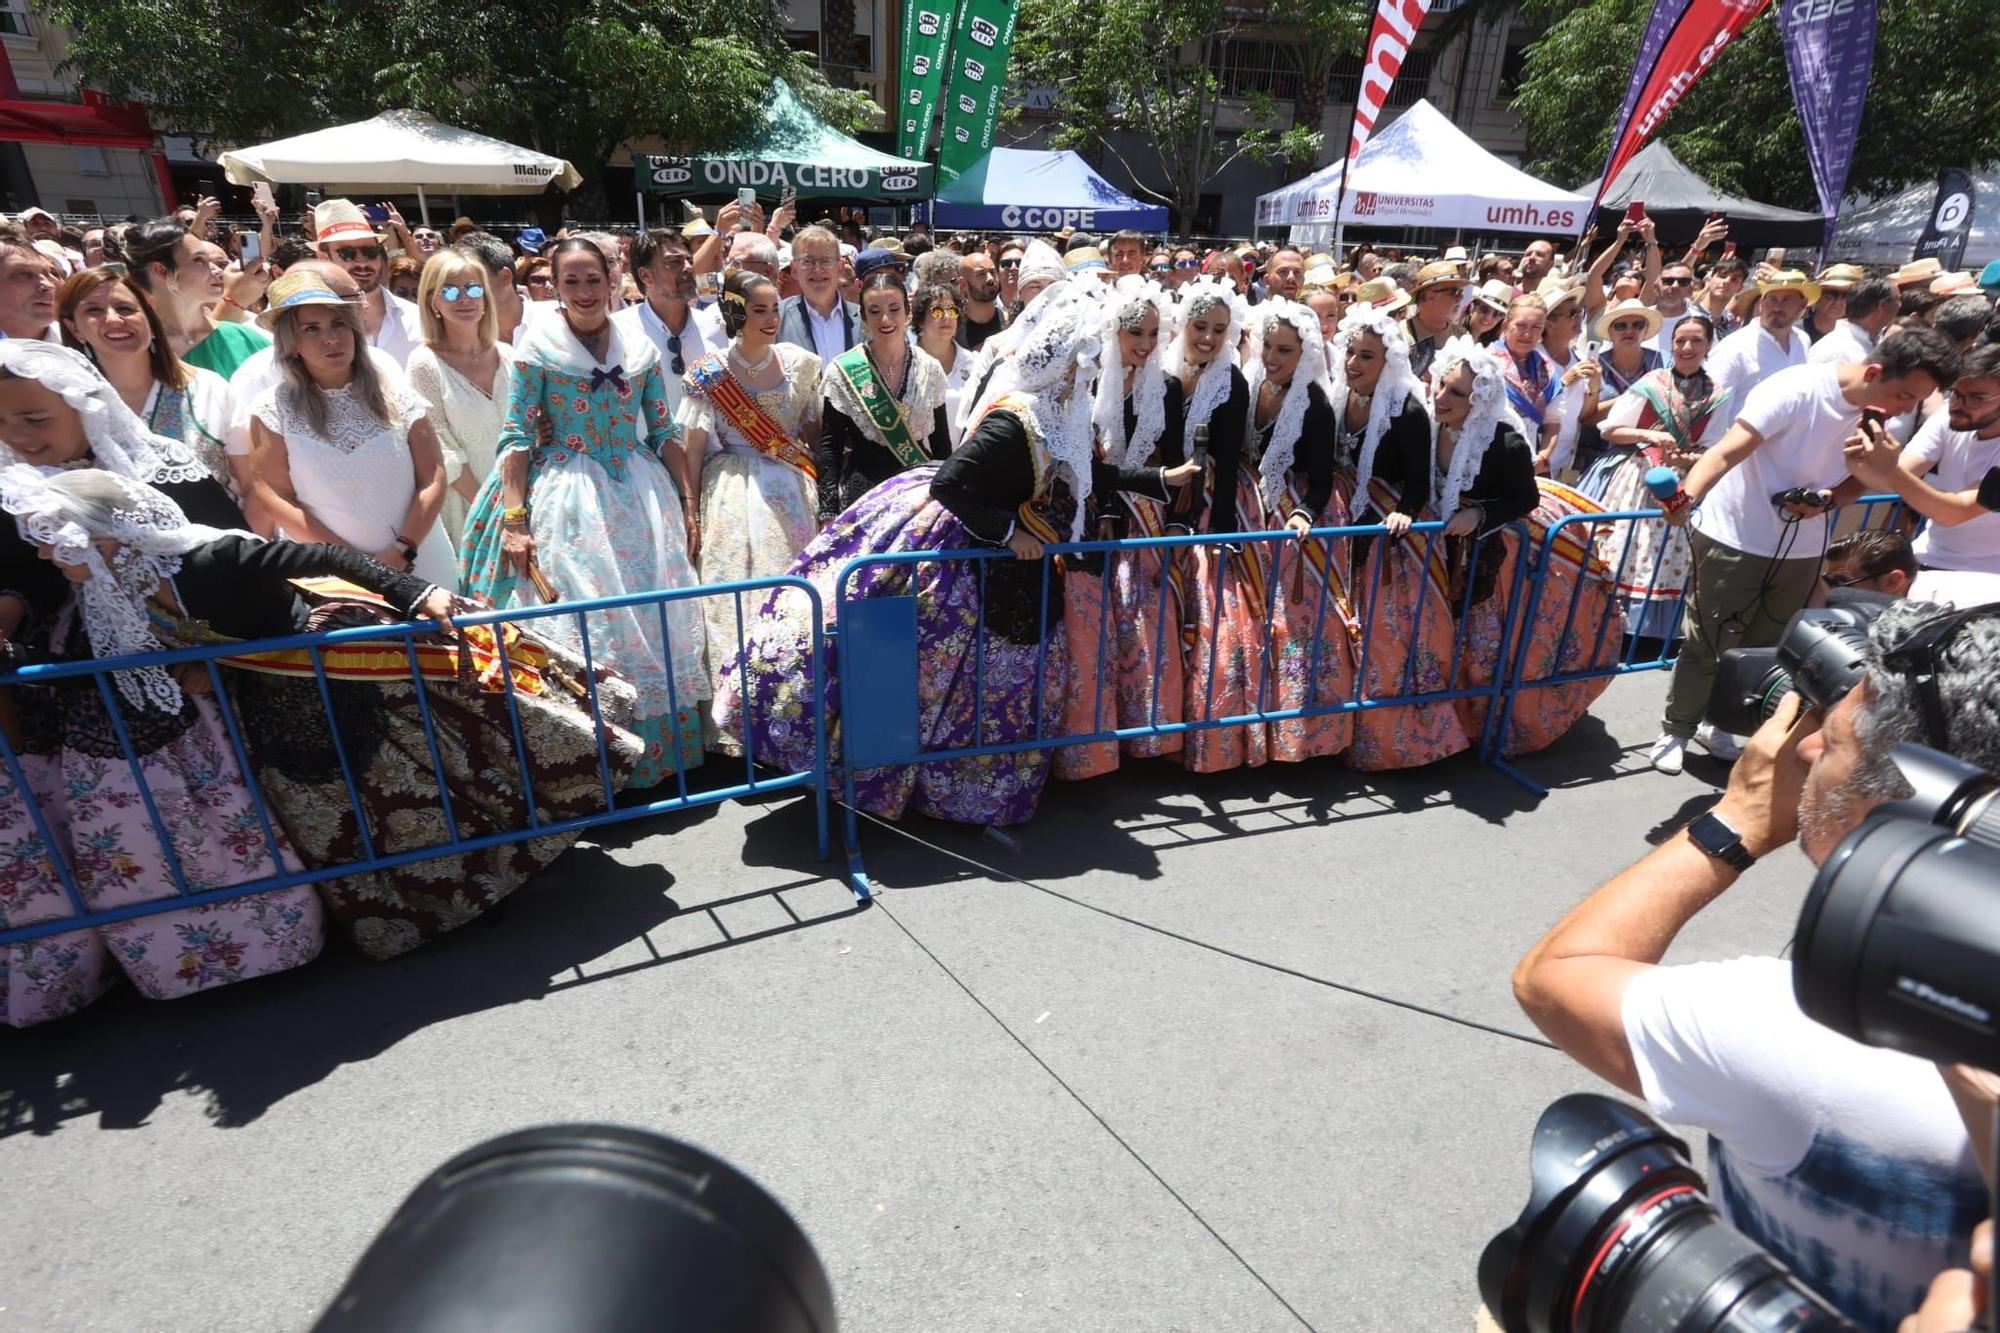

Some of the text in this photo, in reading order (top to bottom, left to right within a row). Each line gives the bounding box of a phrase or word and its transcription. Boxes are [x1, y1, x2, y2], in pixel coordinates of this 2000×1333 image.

[936, 42, 946, 70] ONDA
[942, 12, 951, 41] CERO
[1003, 13, 1017, 45] ONDA
[981, 85, 999, 148] ONDA CERO
[918, 102, 932, 156] ONDA CERO
[657, 171, 687, 181] CERO
[704, 160, 869, 189] ONDA CERO
[886, 178, 913, 187] CERO
[1297, 196, 1330, 217] umh.es
[1377, 195, 1434, 208] UNIVERSITAS
[1024, 207, 1095, 229] COPE
[1486, 203, 1575, 227] umh.es
